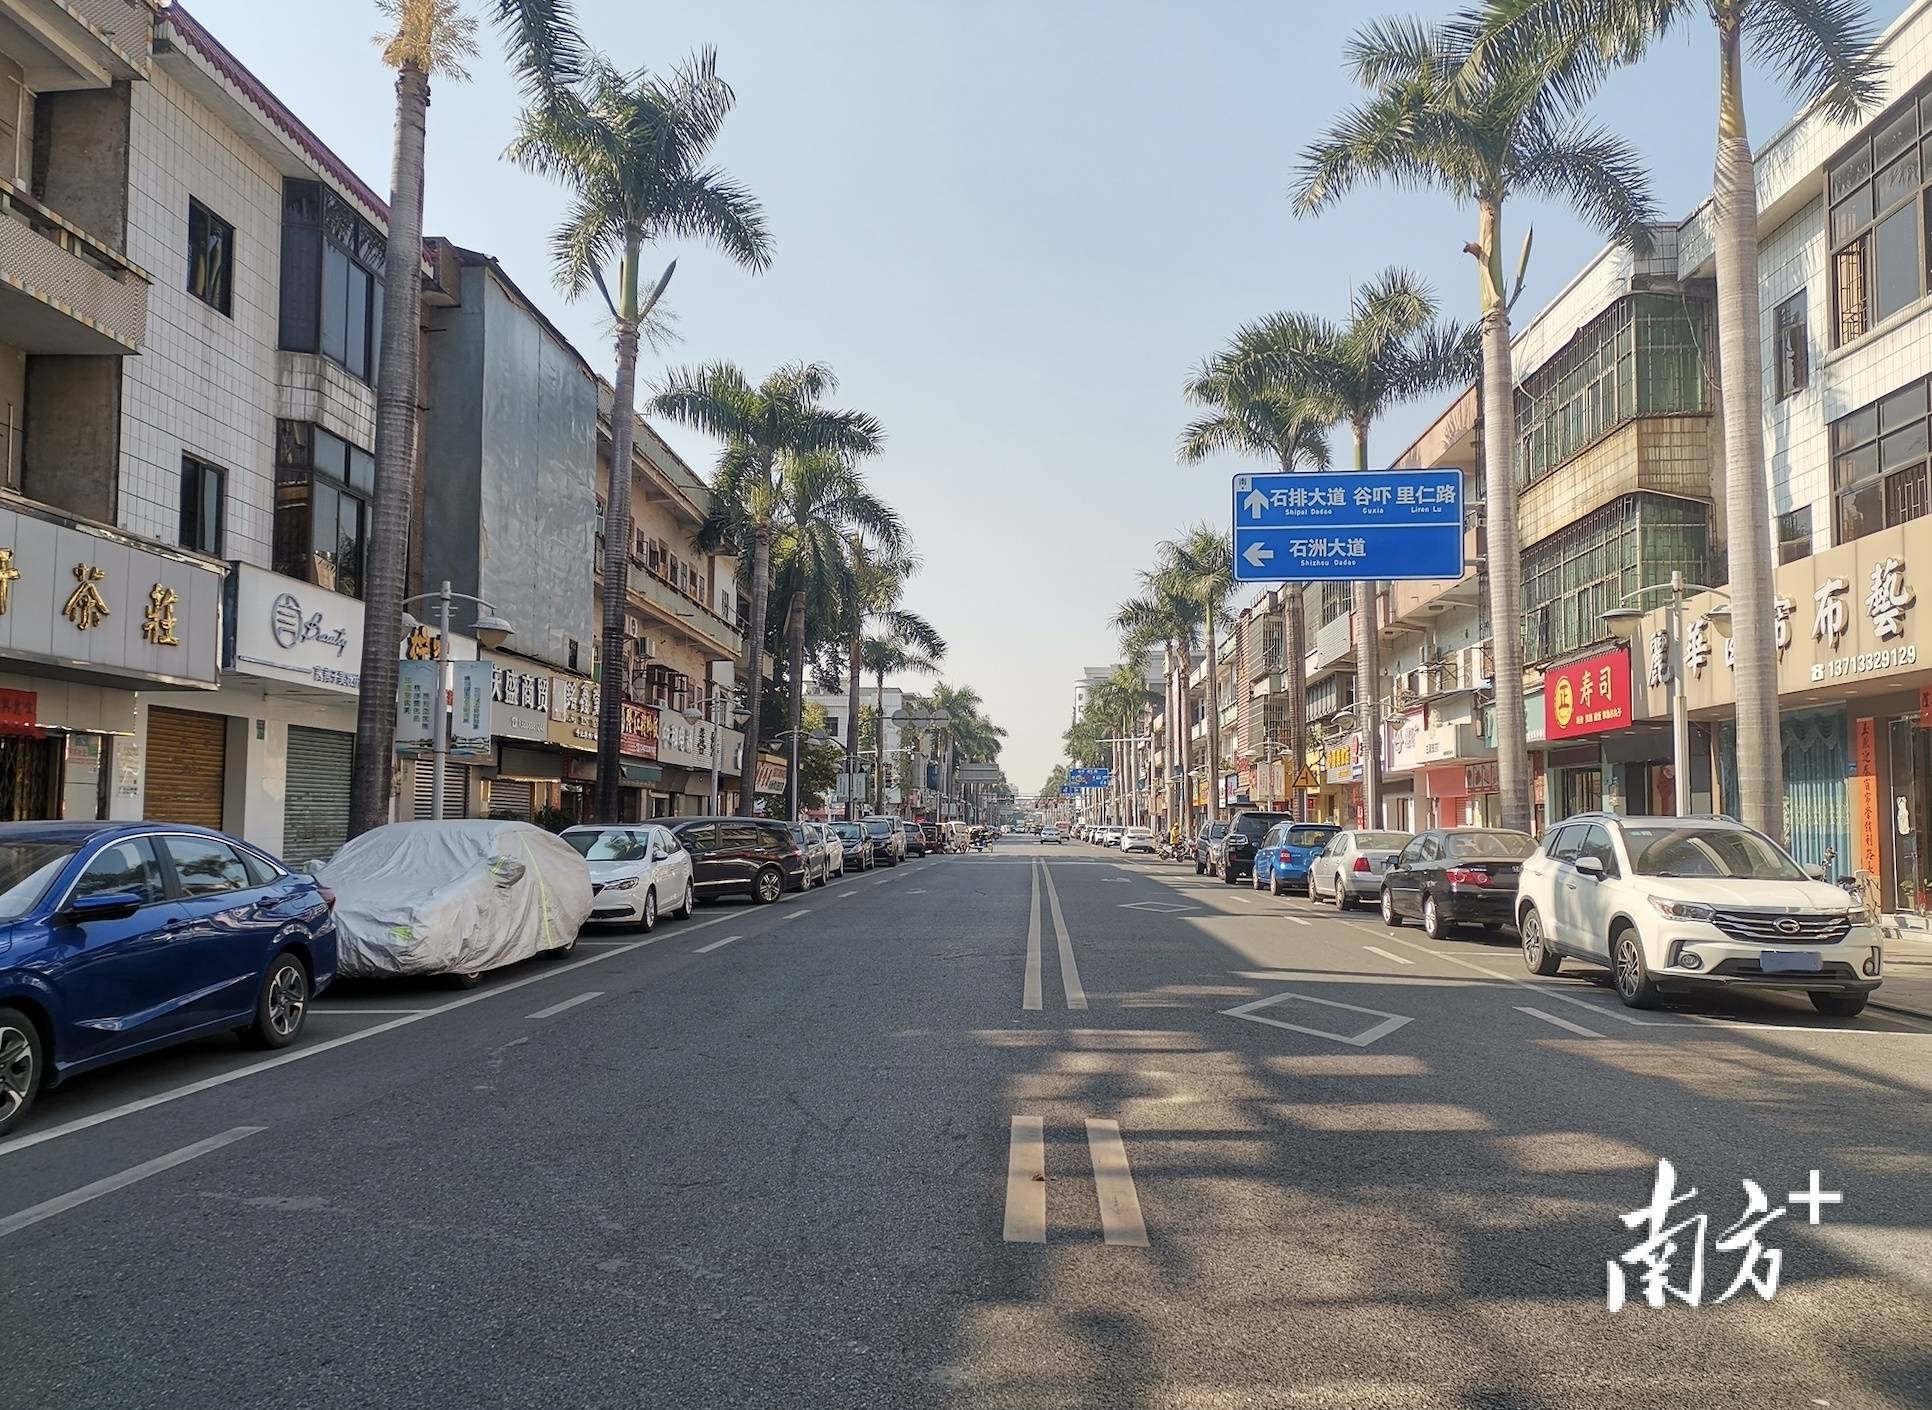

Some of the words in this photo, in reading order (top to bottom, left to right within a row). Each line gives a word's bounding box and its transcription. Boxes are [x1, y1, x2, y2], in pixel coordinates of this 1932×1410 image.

[1270, 487, 1346, 507] 石排大道
[1352, 486, 1392, 506] 谷吓
[1395, 485, 1457, 504] 里仁路
[1284, 508, 1308, 516] Shipai
[1310, 507, 1333, 515] Dadao
[1362, 507, 1384, 515] Guxia
[1410, 505, 1429, 514] Liren
[1432, 505, 1442, 513] Lu
[1289, 537, 1367, 558] 石洲大道
[1300, 559, 1330, 567] Shizhou
[1333, 559, 1357, 567] Dadao
[300, 611, 348, 658] Beauty
[1828, 644, 1917, 678] 13713329129
[1579, 665, 1613, 708] 寿司
